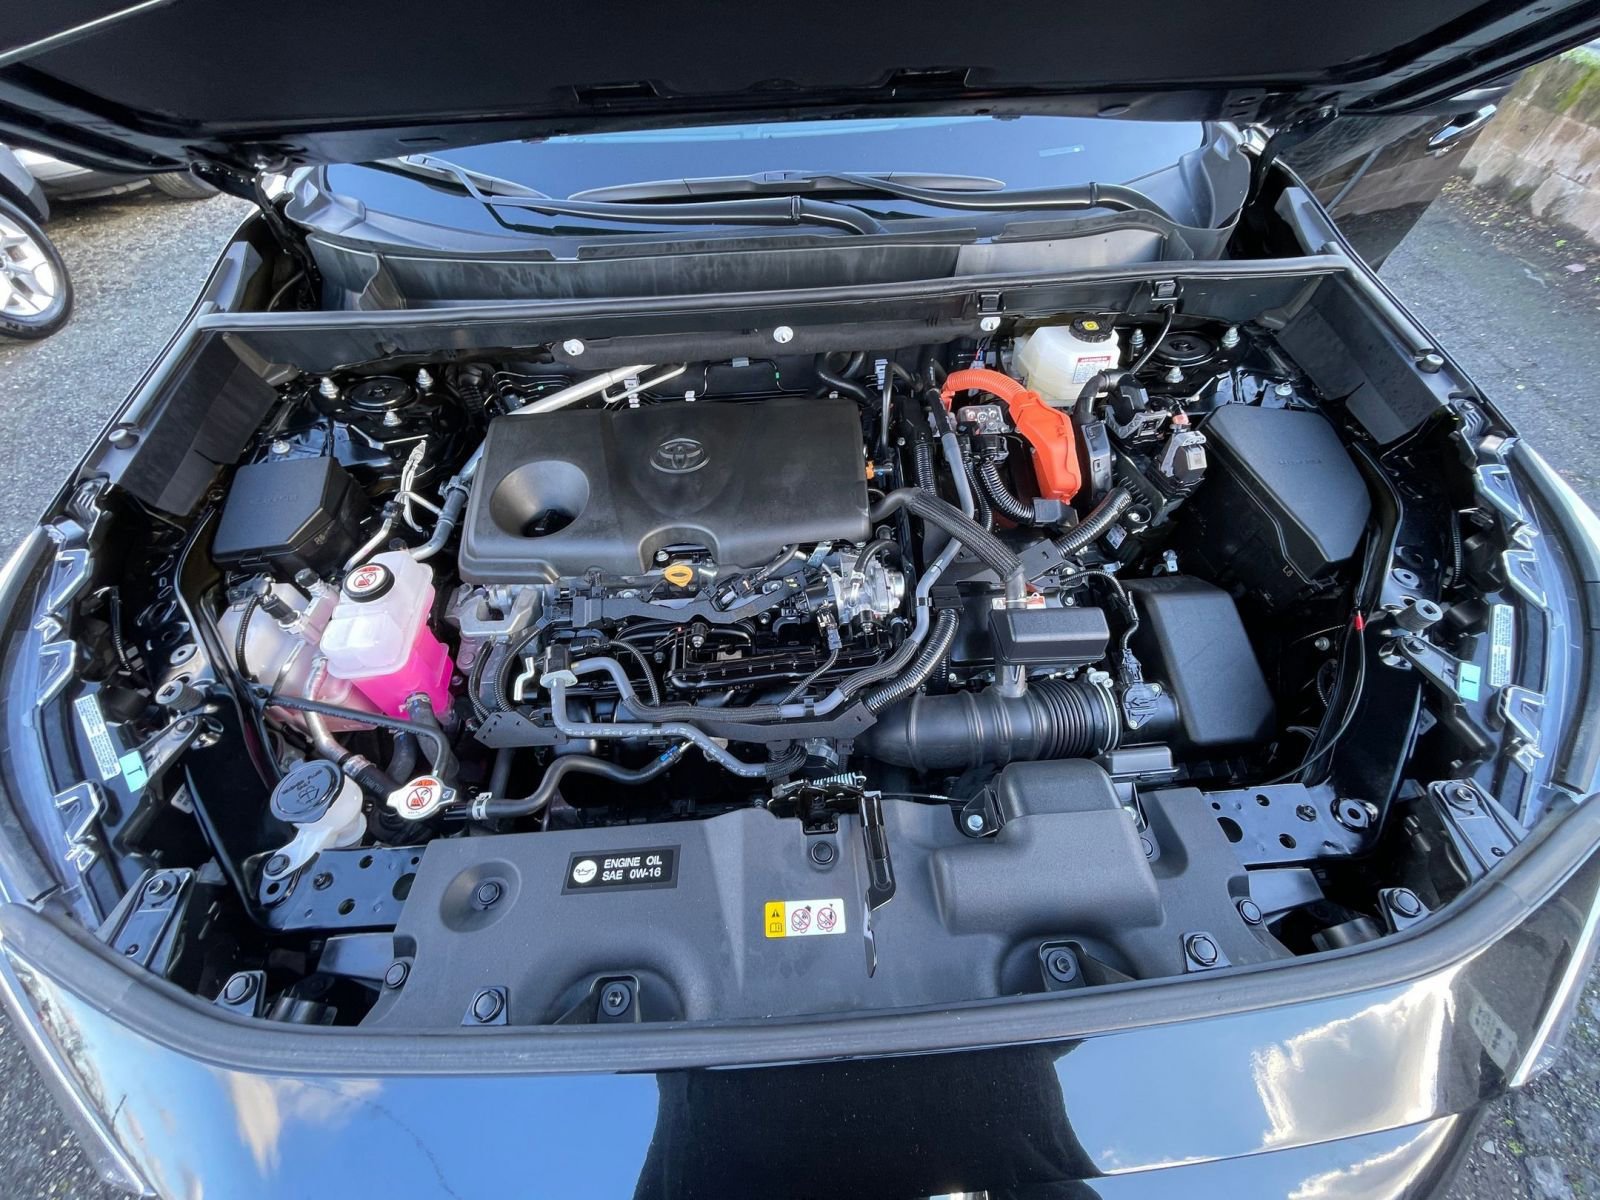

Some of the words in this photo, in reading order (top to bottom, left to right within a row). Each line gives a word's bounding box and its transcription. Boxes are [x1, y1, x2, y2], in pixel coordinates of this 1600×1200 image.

[603, 856, 641, 869] ENGINE
[645, 855, 663, 866] OIL
[602, 869, 624, 881] SAE
[629, 867, 662, 879] 0W-16
